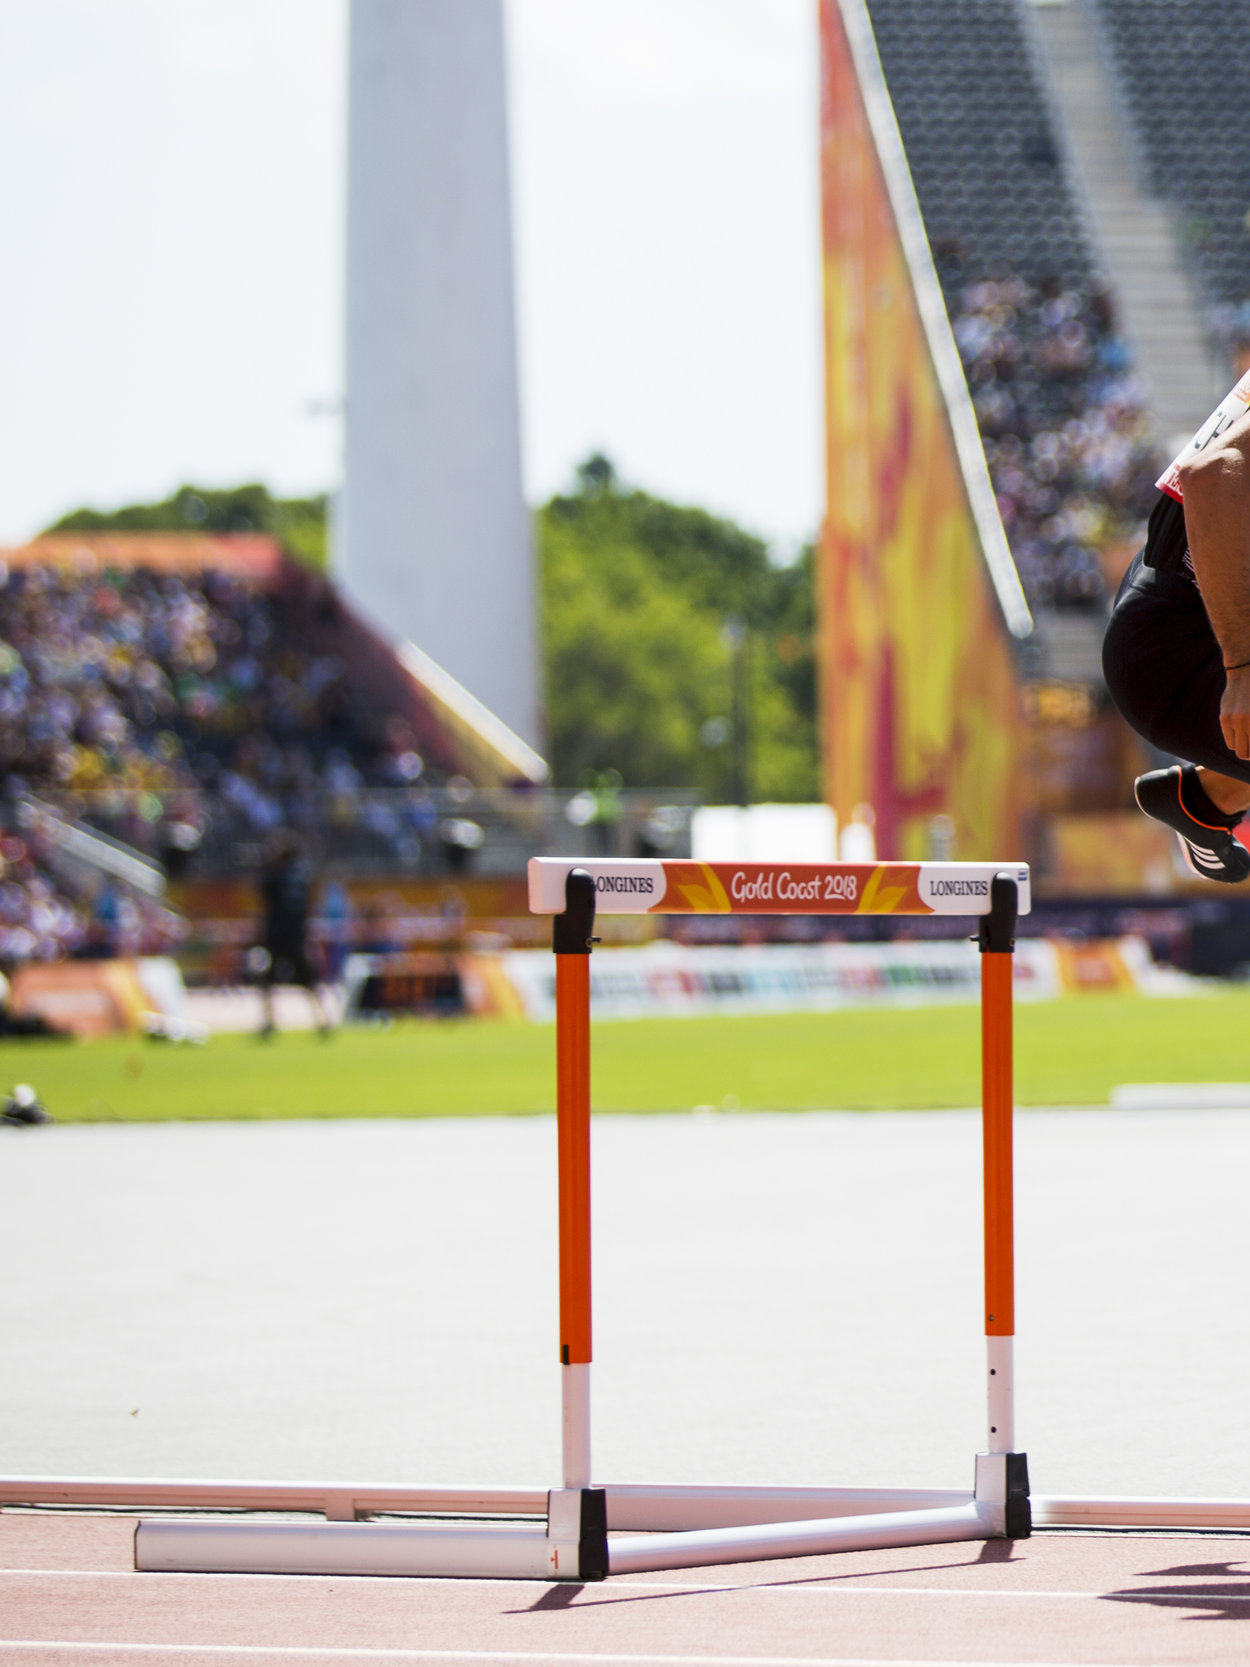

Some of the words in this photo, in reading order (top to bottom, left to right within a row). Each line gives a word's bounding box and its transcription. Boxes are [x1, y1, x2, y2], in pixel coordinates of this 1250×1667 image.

[595, 875, 654, 894] ONGINES
[731, 871, 774, 903] Gold
[776, 871, 822, 900] Coast
[823, 874, 857, 901] 2018
[930, 880, 988, 896] LONGINES
